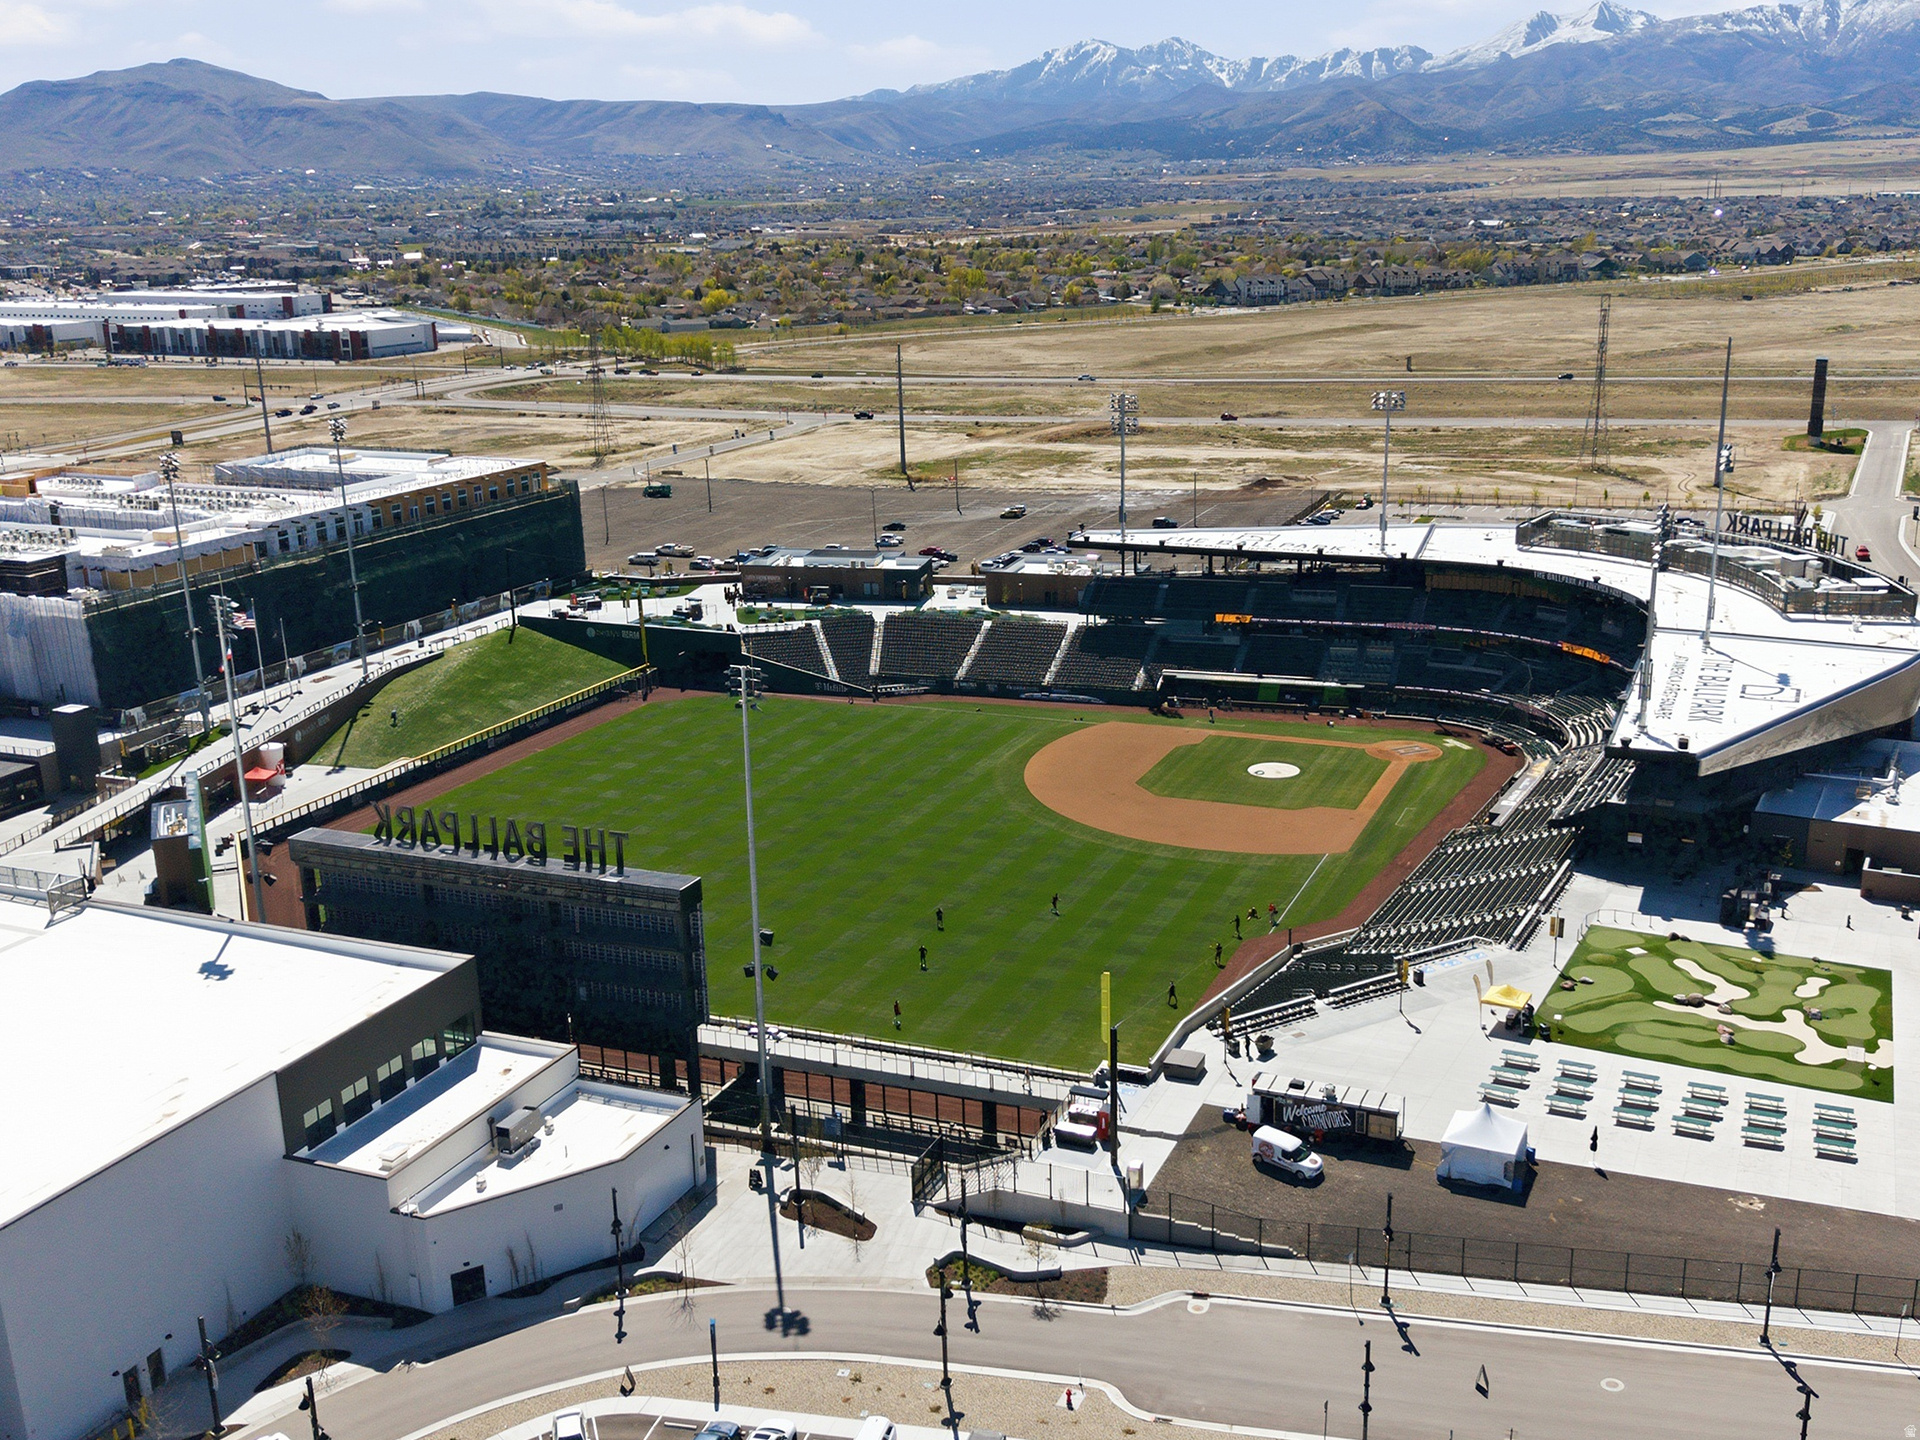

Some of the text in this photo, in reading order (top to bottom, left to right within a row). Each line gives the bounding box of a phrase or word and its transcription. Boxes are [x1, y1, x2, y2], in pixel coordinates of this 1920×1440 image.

[1687, 675, 1731, 724] BALLPARK
[1282, 1104, 1327, 1123] Welcome
[1301, 1109, 1352, 1130] CARNIVORES
